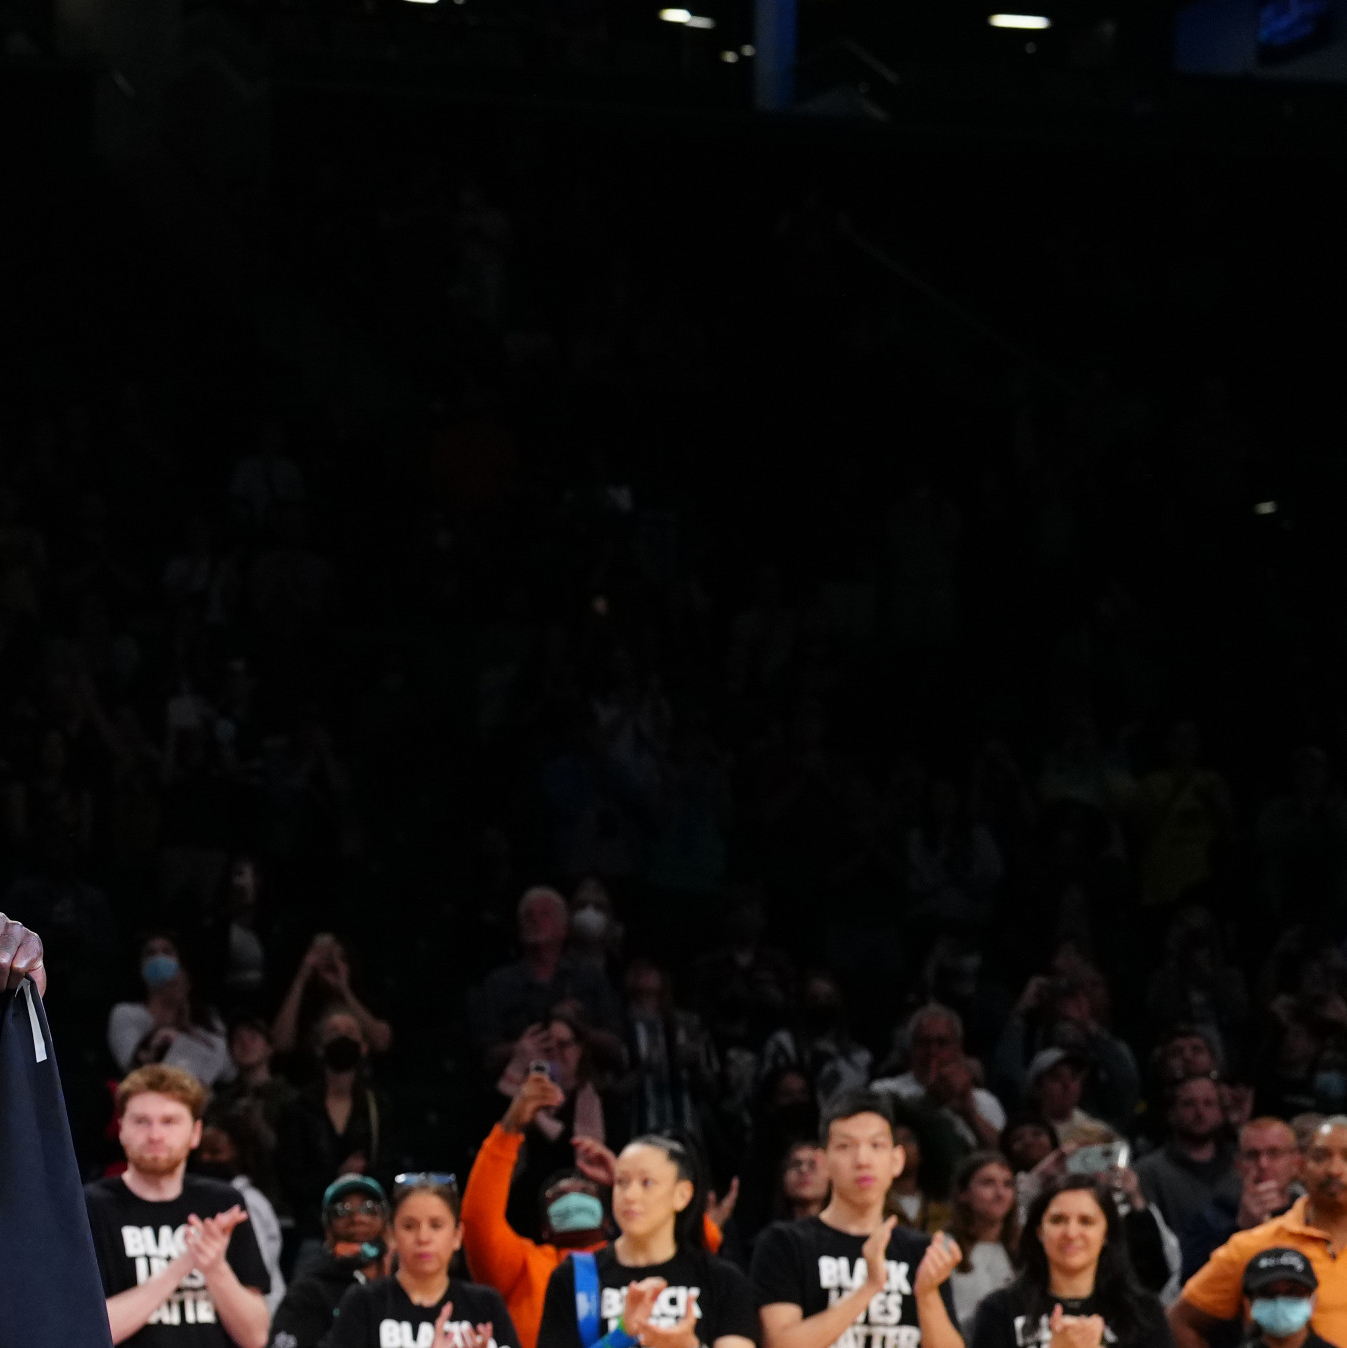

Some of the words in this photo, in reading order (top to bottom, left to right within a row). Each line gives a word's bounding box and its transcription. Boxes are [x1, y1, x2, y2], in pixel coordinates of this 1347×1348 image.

[121, 1223, 202, 1258] BLA
[818, 1255, 912, 1295] BLAK
[601, 1286, 702, 1319] BCK
